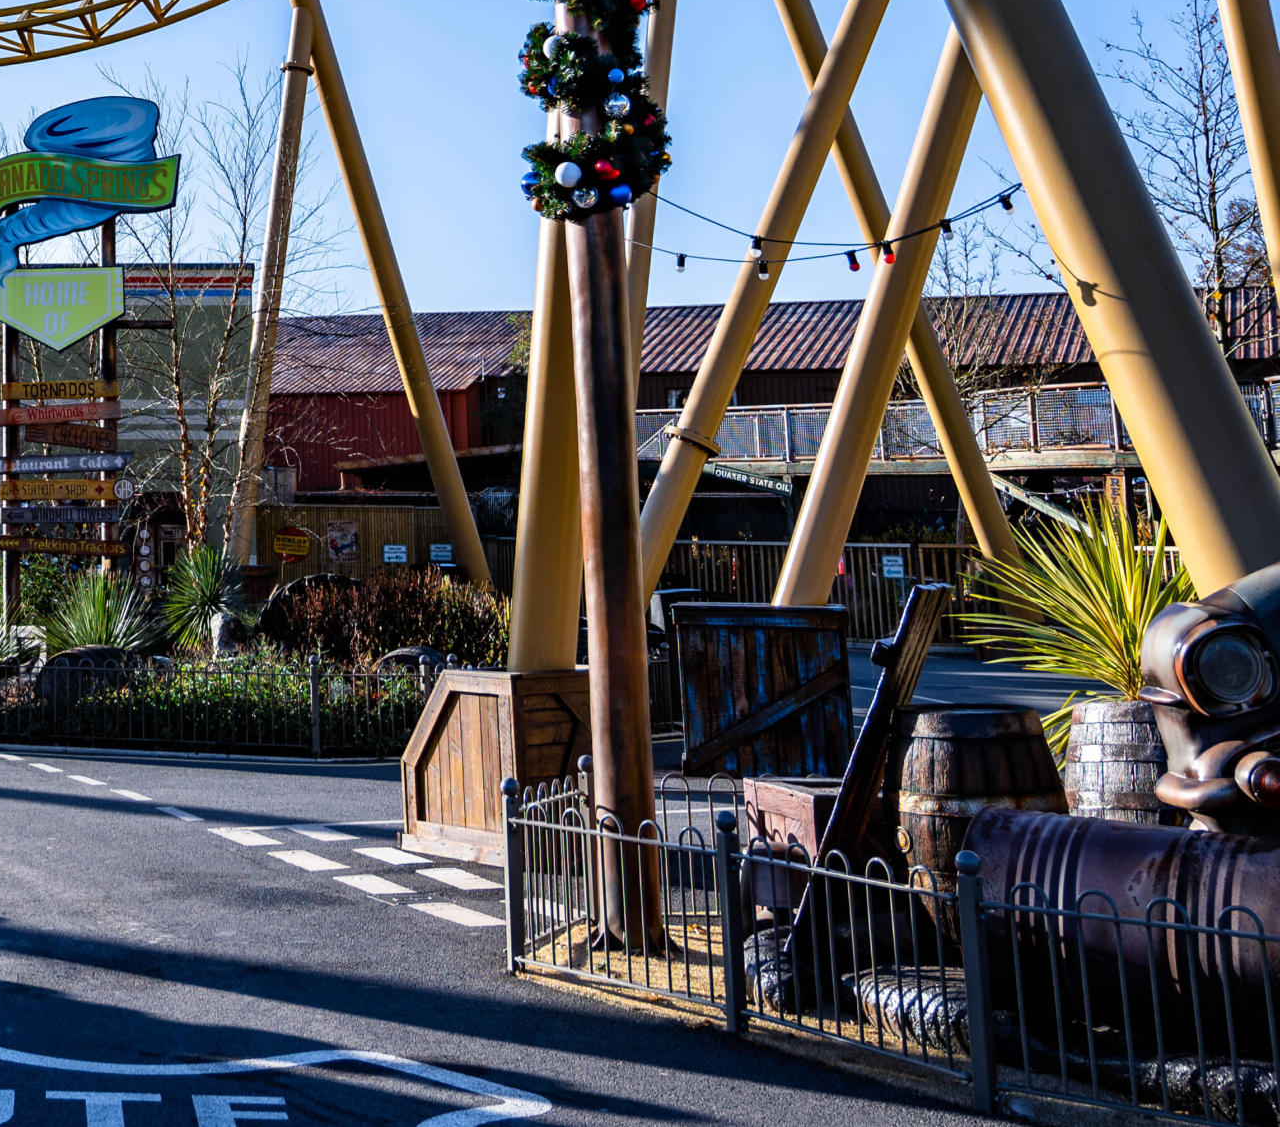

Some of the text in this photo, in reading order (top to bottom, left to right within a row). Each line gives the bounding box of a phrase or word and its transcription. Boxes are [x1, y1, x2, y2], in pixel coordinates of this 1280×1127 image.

[71, 160, 168, 200] SPRINGS
[24, 282, 90, 306] HOME
[43, 312, 71, 336] OF
[22, 382, 96, 398] TORNADOS
[27, 405, 84, 421] Whirlwinds
[52, 425, 112, 448] CYCLONES
[79, 456, 110, 469] Cafe
[715, 469, 790, 492] QUAKER STATE OIL
[2, 484, 88, 496] GAS STATION SHOP
[115, 480, 134, 499] GAS
[31, 509, 113, 521] WINDMILL TOWERS
[27, 538, 125, 554] Trekking Tractors
